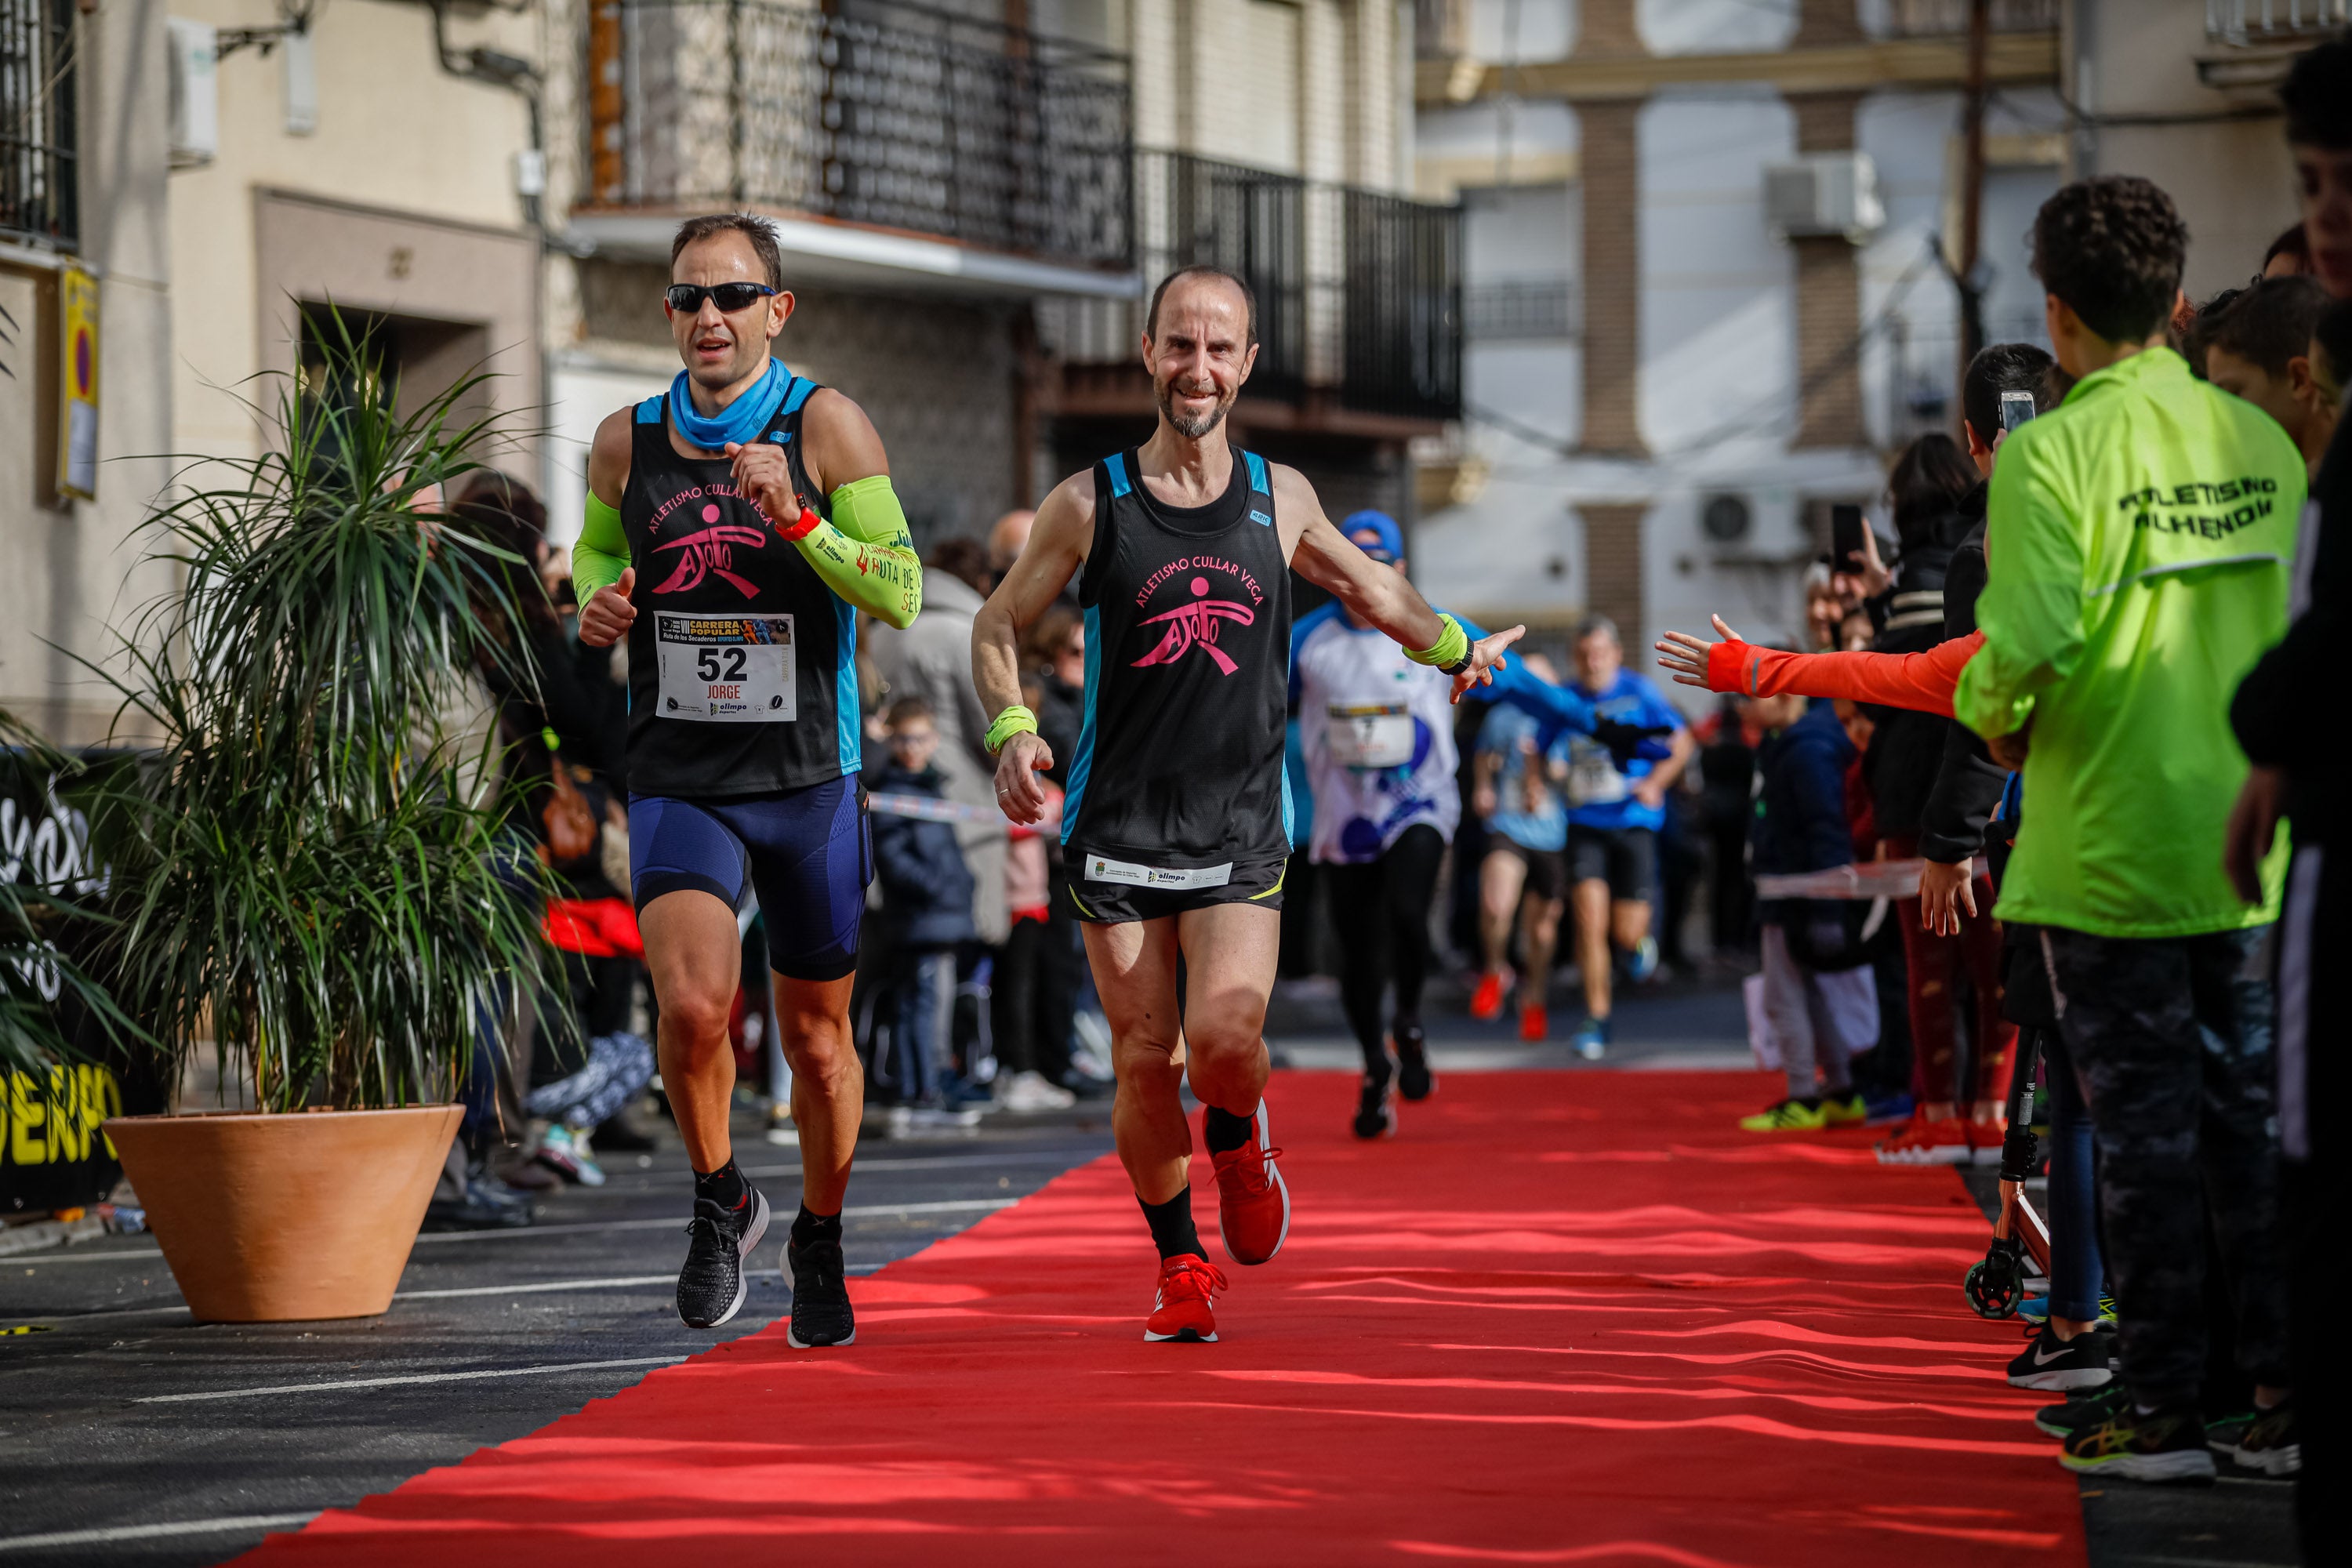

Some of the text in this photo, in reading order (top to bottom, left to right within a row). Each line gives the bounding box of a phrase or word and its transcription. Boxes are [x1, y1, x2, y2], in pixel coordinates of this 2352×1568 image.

[648, 487, 702, 535] ATLETISMO
[826, 545, 844, 564] olimpo
[872, 558, 898, 585] RUTA
[903, 568, 914, 590] DE
[1136, 556, 1264, 608] ATLETISMO CULLAR VEGA
[902, 593, 922, 613] SEC
[681, 619, 690, 634] VII
[689, 620, 739, 630] CARRERA
[697, 648, 748, 682] 52
[707, 684, 741, 699] JORGE
[720, 702, 747, 712] olimpo
[1159, 873, 1185, 881] olimpo
